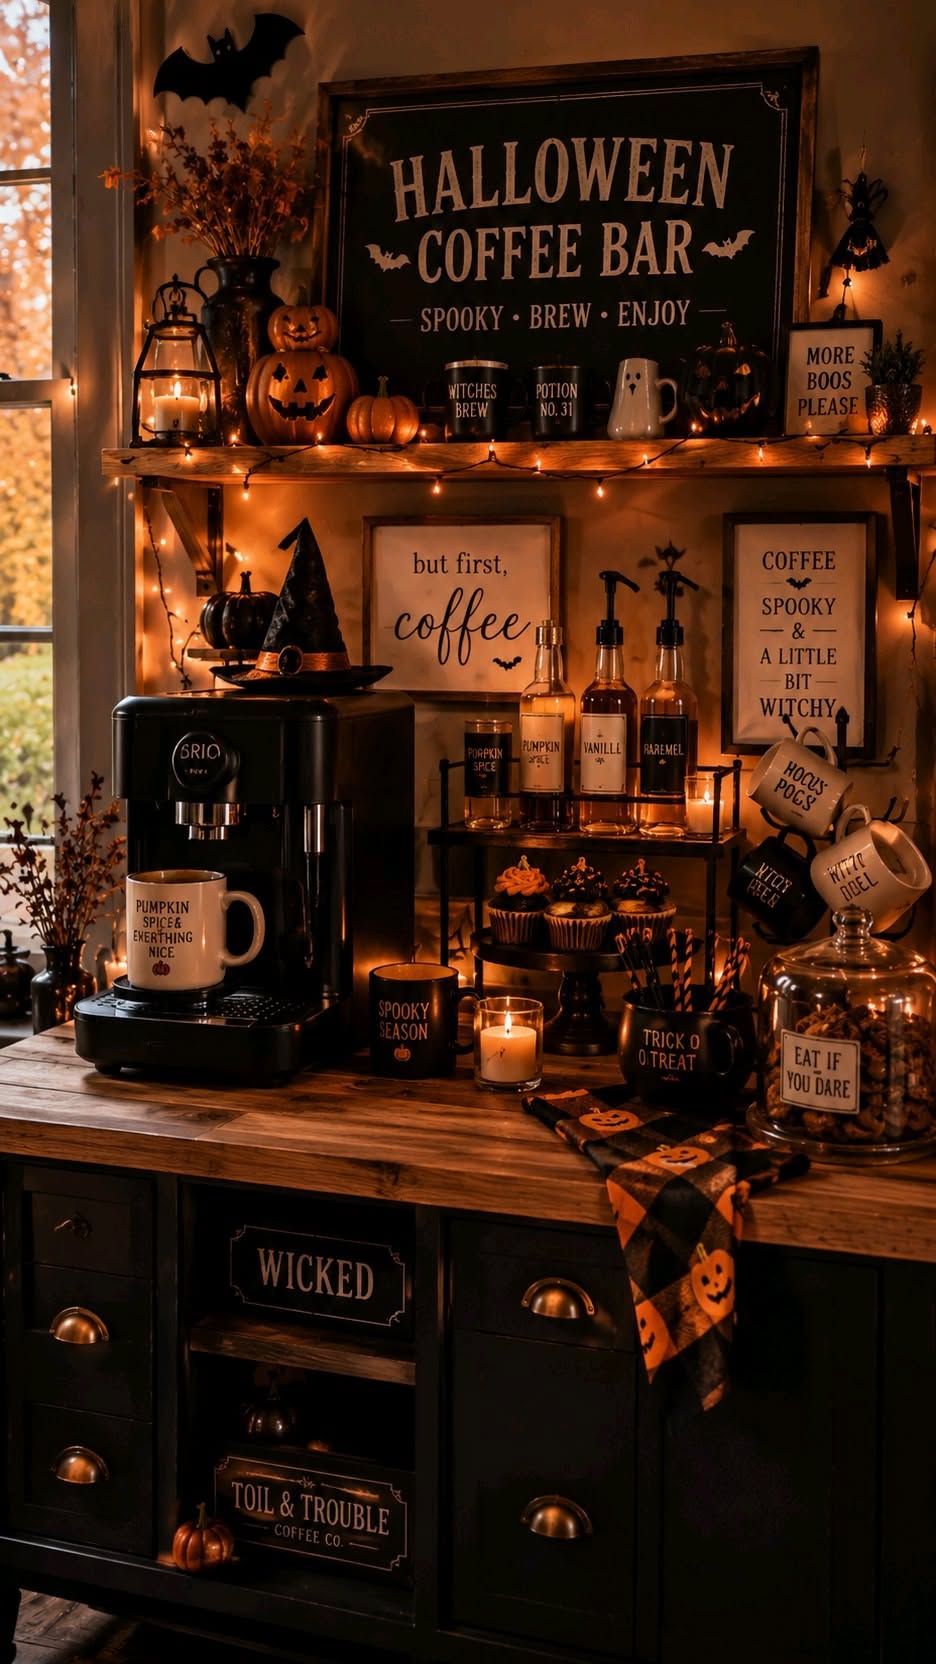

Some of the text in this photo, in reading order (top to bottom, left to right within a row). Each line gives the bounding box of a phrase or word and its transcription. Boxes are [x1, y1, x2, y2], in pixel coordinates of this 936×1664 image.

[390, 137, 735, 223] HALLOWEEN
[417, 219, 693, 284] COFFEE BAR
[420, 300, 691, 332] SPOOKY BREW ENJOY
[807, 346, 855, 365] MORE
[807, 371, 852, 390] BOOS
[449, 383, 497, 399] WITCHES
[536, 383, 577, 399] POTION
[456, 402, 488, 418] BREW
[540, 402, 572, 417] NO. 31
[798, 397, 858, 416] PLEASE
[413, 552, 507, 577] but first,
[762, 551, 836, 570] COFFEE
[762, 598, 836, 616] SPOOKY
[395, 587, 531, 666] coffee
[792, 622, 805, 640] &
[760, 648, 837, 665] A LITTLE
[785, 673, 812, 690] BIT
[760, 697, 837, 718] WITCHY
[136, 899, 190, 914] PUMPKIN
[149, 946, 175, 958] NICE
[378, 1000, 430, 1020] SPOOKY
[379, 1021, 428, 1041] SEASON
[643, 1028, 685, 1050] TRICK
[650, 1050, 697, 1071] TREAT
[795, 1047, 842, 1071] EAT IF
[787, 1071, 851, 1099] YOU DARE
[257, 1248, 374, 1300] WICKED
[232, 1481, 390, 1536] TOIL & TROUBLE
[274, 1523, 344, 1548] COFFEE CO.
